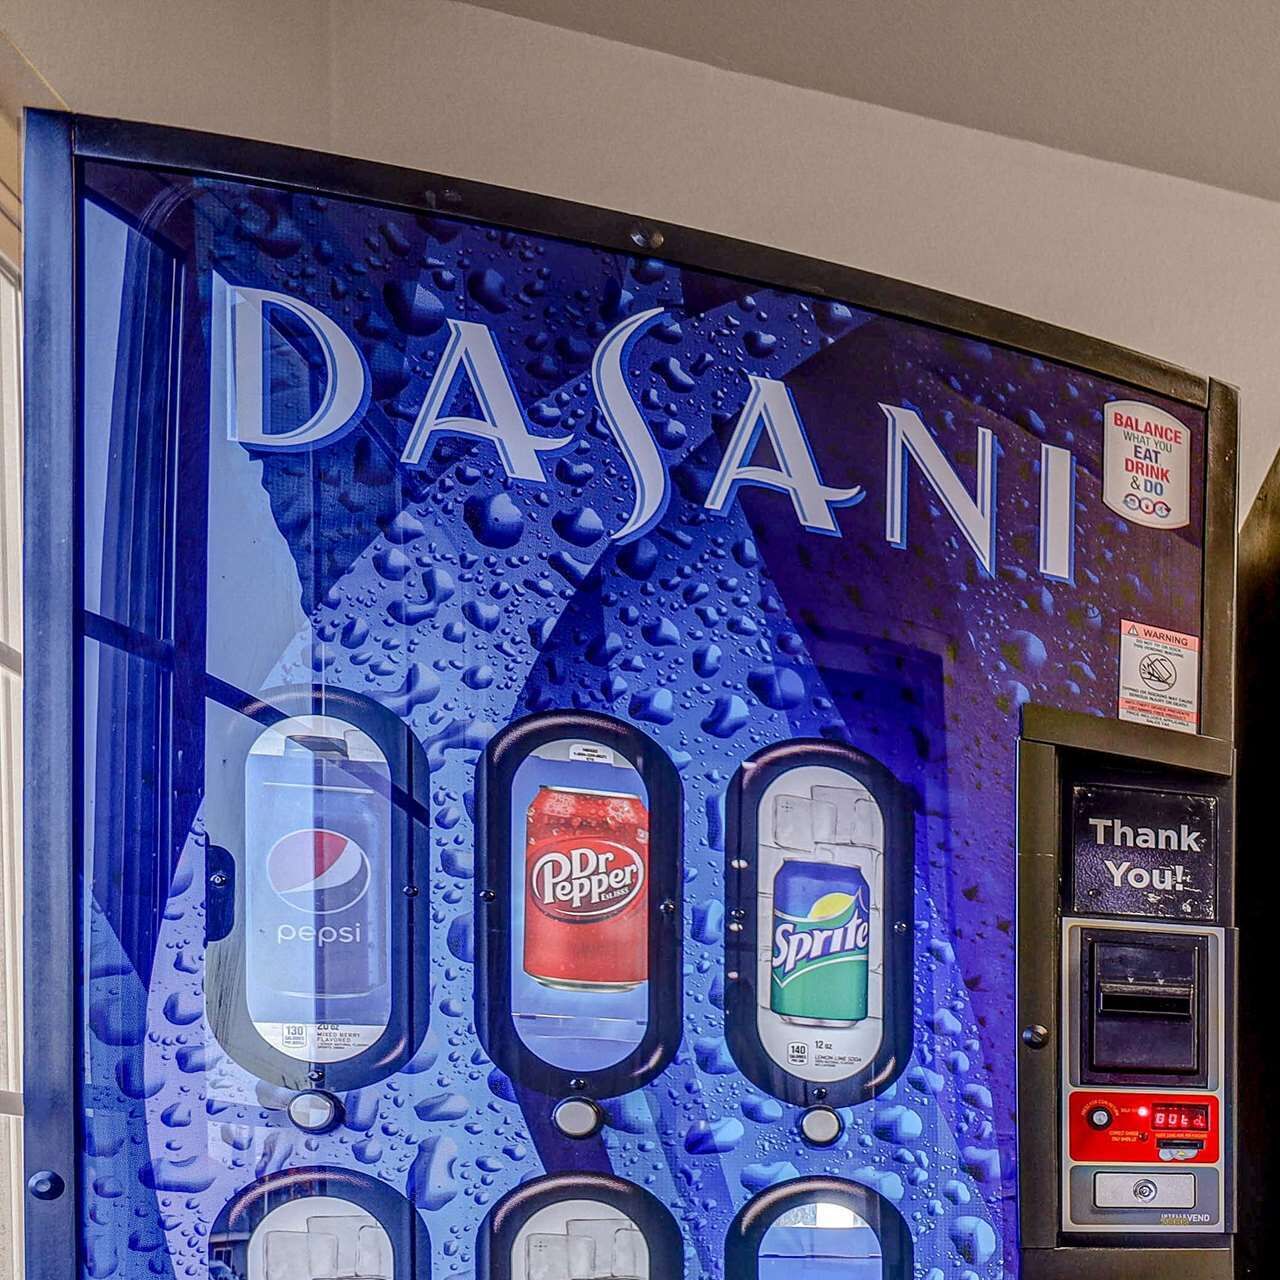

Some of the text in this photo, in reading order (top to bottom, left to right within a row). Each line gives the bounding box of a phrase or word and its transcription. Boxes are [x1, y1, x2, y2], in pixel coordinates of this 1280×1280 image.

[213, 272, 1076, 584] DASANI
[1113, 412, 1183, 445] BALANCE
[1123, 430, 1173, 454] WHAT YOU
[1134, 445, 1161, 465] EAT
[1125, 458, 1171, 484] DRINK
[1130, 475, 1164, 497] & DO
[1143, 628, 1189, 646] WARNING
[1088, 818, 1201, 852] Thank
[570, 847, 615, 879] Dr
[1104, 860, 1184, 891] You!
[532, 852, 638, 908] Pepper
[278, 922, 361, 947] pepsi
[772, 908, 868, 974] Sprite
[286, 1025, 304, 1036] 130
[791, 1045, 806, 1055] 140
[815, 1040, 824, 1049] 12
